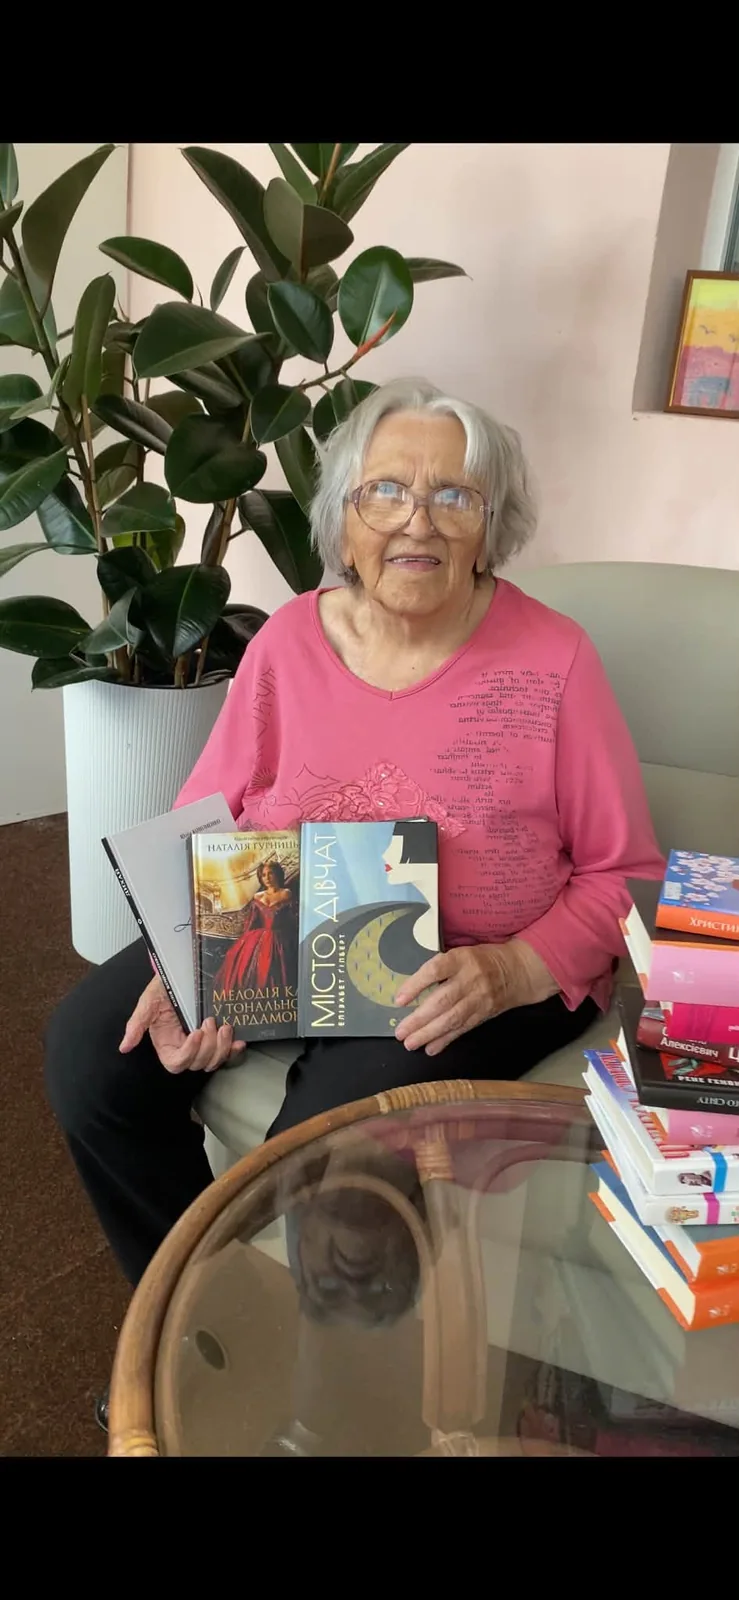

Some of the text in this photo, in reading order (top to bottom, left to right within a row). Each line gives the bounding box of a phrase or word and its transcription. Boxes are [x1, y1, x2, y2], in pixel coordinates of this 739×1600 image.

[207, 843, 250, 852] НАТАЛІЯ
[311, 832, 339, 1028] МІСТО ДІВЧАТ
[212, 986, 279, 1002] МЕЛОДІЯ
[212, 1004, 223, 1016] У
[660, 1036, 719, 1058] Алексієвич
[678, 1075, 706, 1084] РЕНЕ
[696, 1096, 725, 1106] СВІТУ
